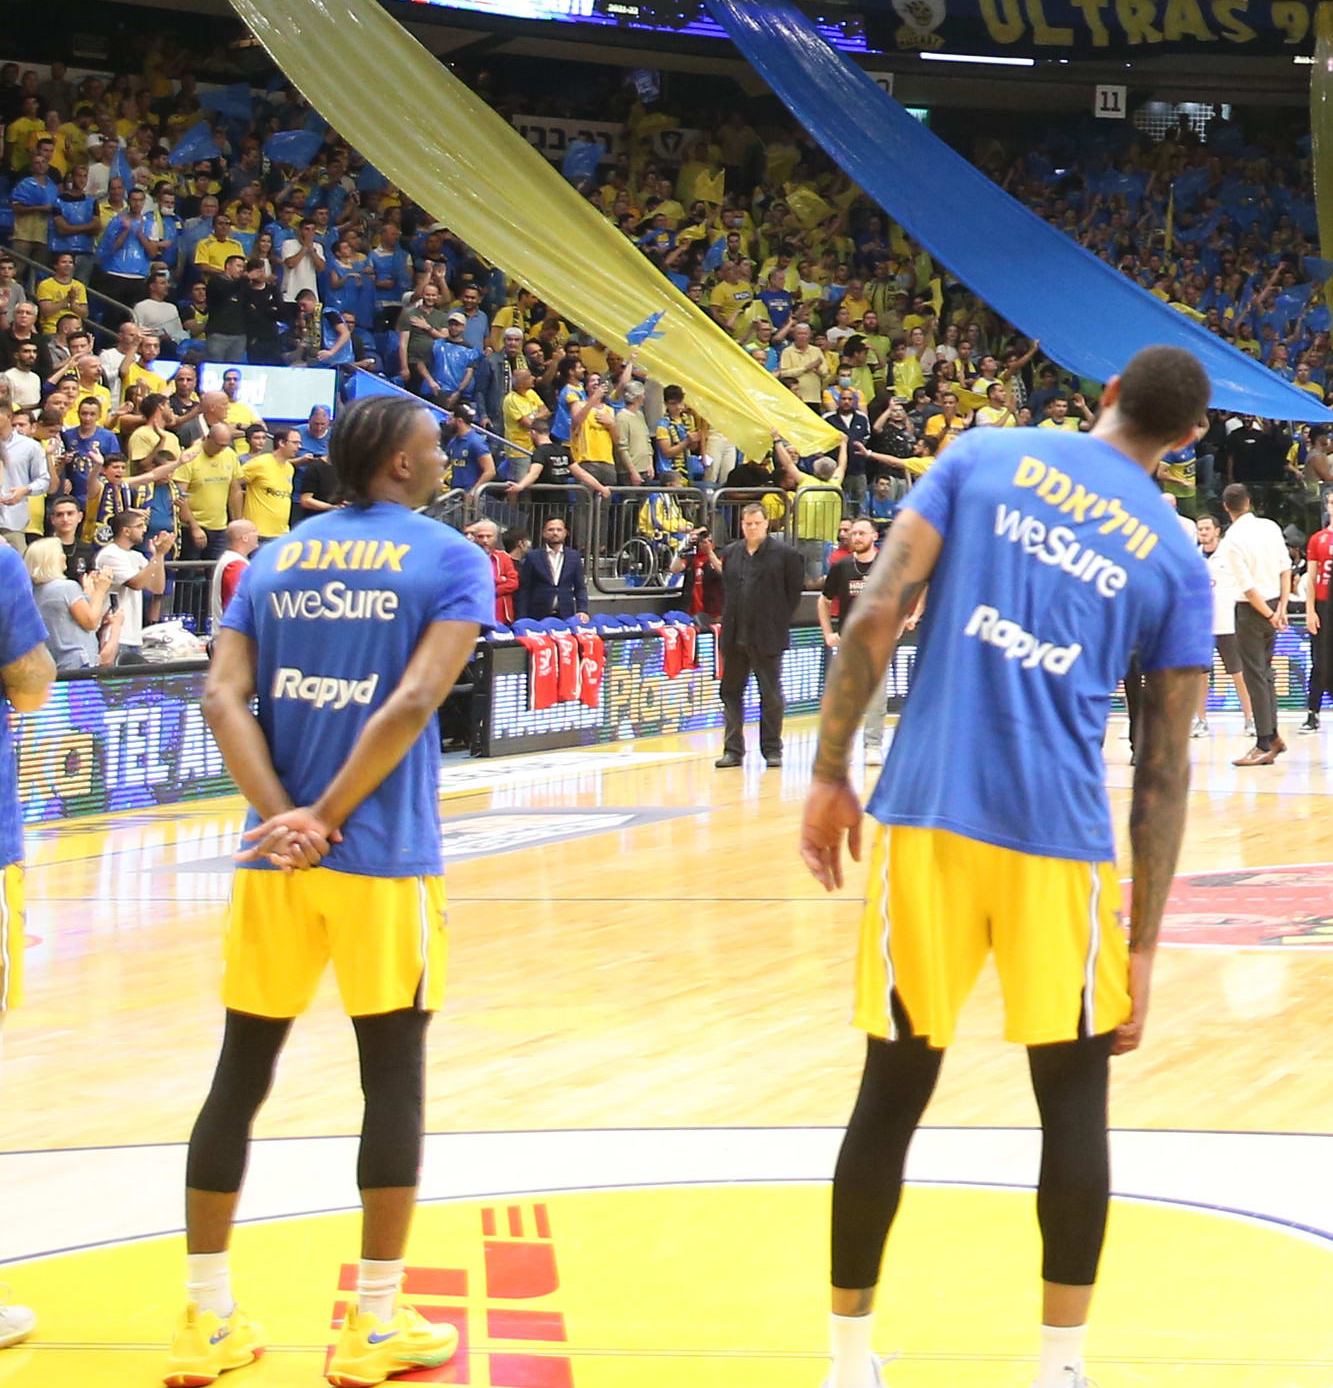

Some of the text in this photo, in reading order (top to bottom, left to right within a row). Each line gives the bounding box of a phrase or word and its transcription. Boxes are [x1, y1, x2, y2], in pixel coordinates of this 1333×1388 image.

[1100, 91, 1122, 111] 11
[1012, 455, 1160, 561] וויליאמס
[275, 541, 411, 573] אוואנס
[995, 505, 1128, 598] weSure
[271, 580, 399, 621] weSure
[965, 605, 1082, 676] Rapyd
[273, 668, 379, 709] Rapyd
[104, 706, 170, 789] TEL
